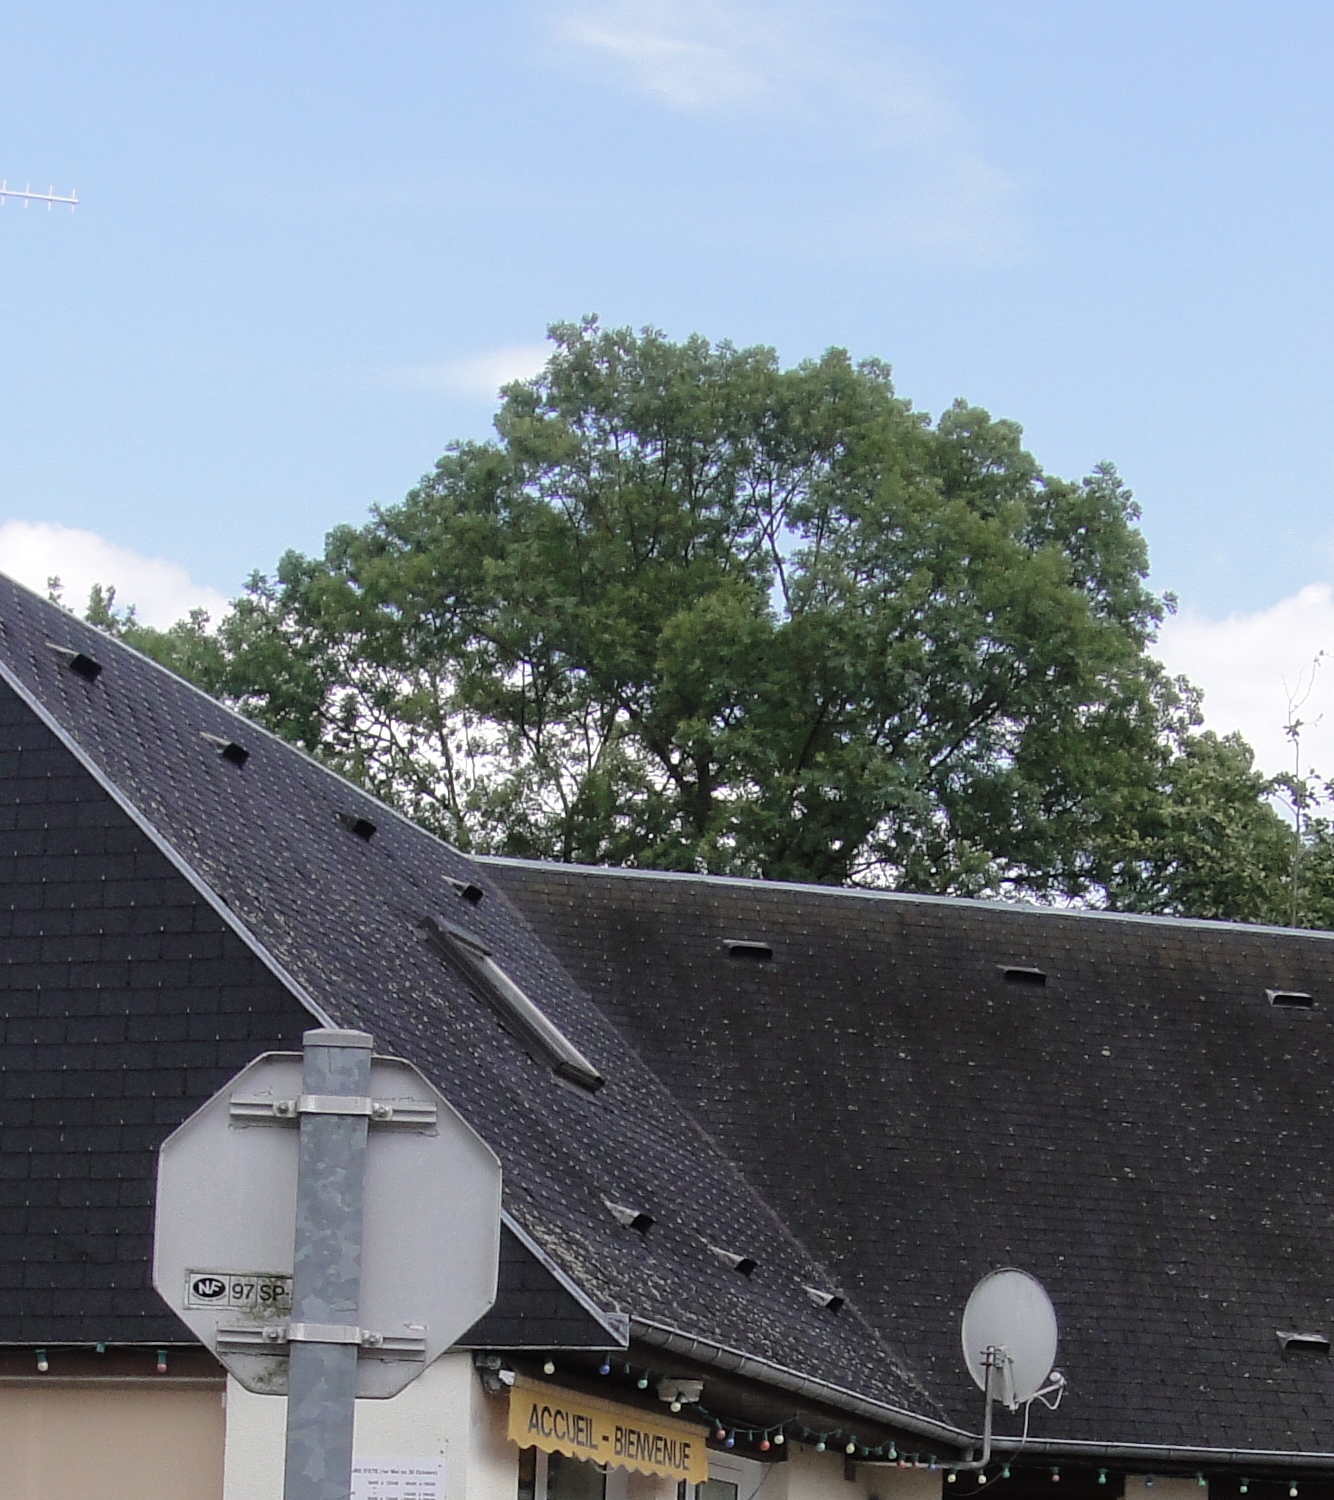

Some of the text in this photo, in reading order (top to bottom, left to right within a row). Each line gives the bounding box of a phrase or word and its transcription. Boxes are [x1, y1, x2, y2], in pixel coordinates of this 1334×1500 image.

[198, 1280, 224, 1294] NF
[232, 1283, 255, 1300] 97
[259, 1284, 293, 1302] SP-
[528, 1403, 598, 1450] ACCUEIL
[614, 1425, 691, 1470] BIENVENUE
